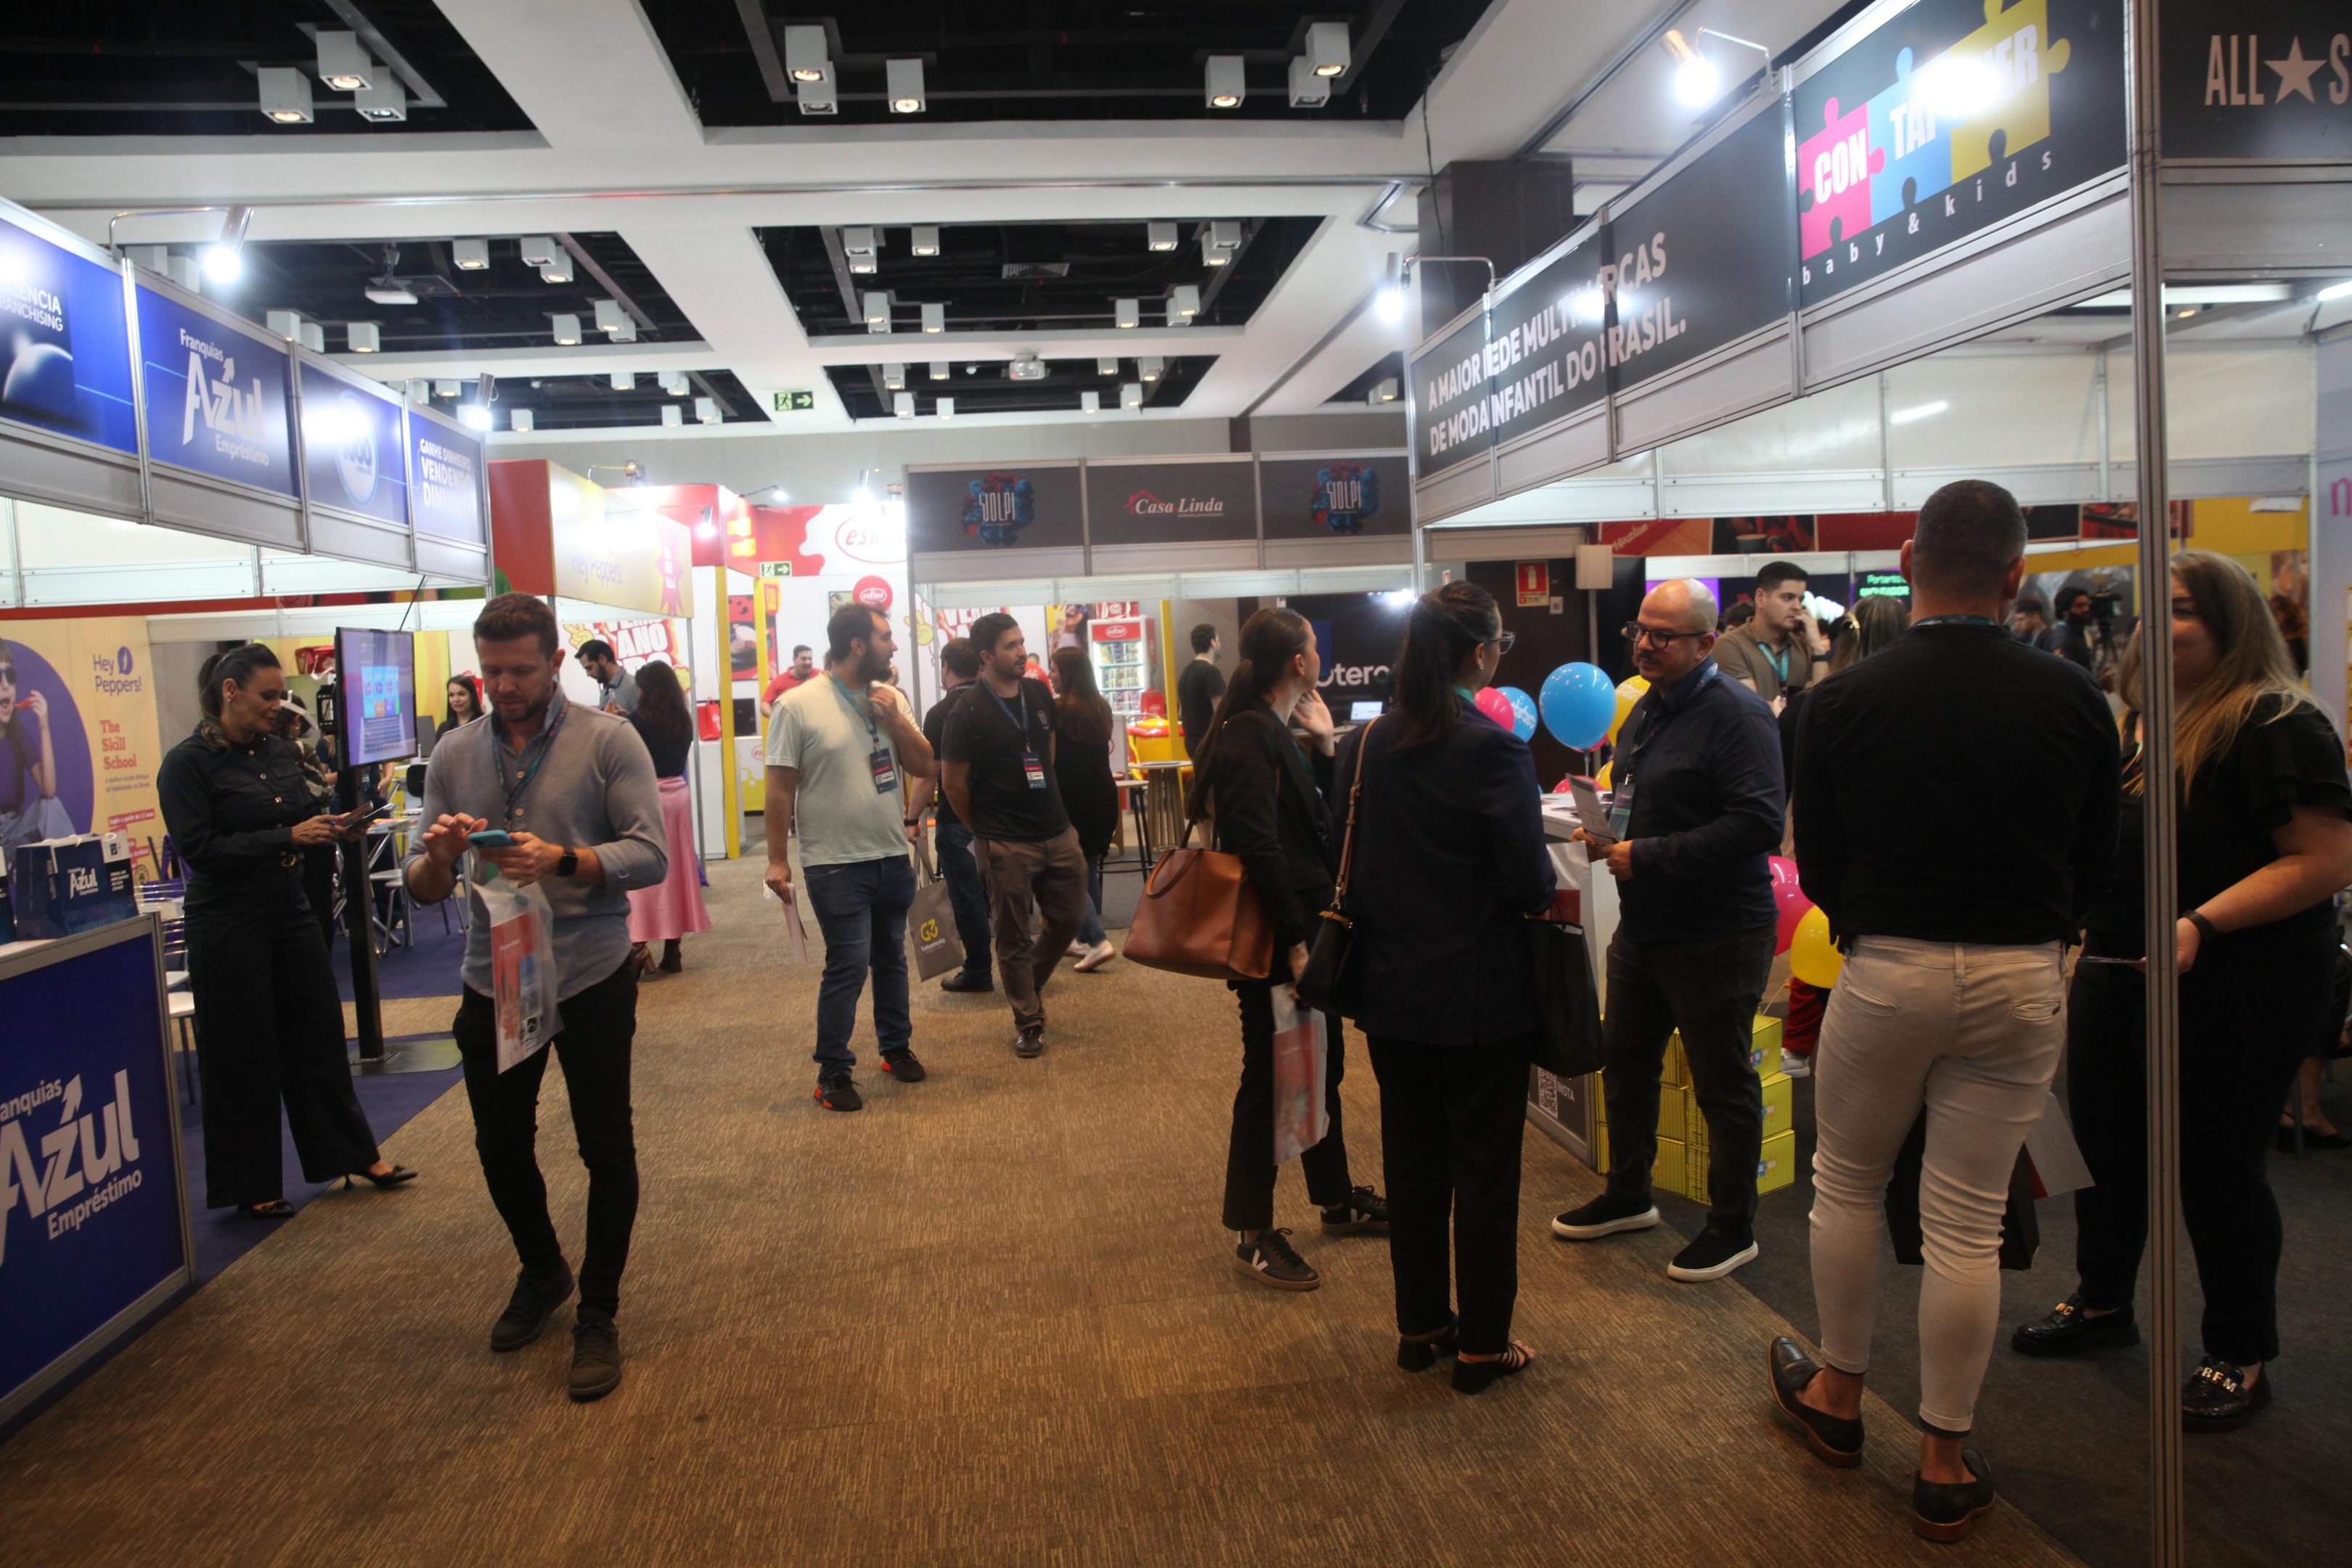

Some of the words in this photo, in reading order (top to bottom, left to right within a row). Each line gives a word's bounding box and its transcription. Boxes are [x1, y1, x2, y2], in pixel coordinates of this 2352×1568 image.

[2205, 35, 2265, 106] ALL
[1815, 128, 1867, 204] CON
[1802, 232, 1885, 285] baby
[1908, 212, 1920, 234] &
[1945, 151, 2051, 217] kids
[180, 328, 224, 362] Franquias
[1429, 381, 1438, 412] A
[1439, 354, 1482, 407] MAIOR
[1430, 420, 1447, 456] DE
[1448, 395, 1490, 448] MODA
[1567, 341, 1596, 391] DO
[216, 433, 269, 466] Empréstimo
[420, 438, 442, 460] GANHE
[421, 457, 472, 489] VENDENDO
[1135, 499, 1174, 514] Casa
[1178, 497, 1224, 513] Linda
[617, 621, 669, 659] ANO
[93, 654, 115, 676] Hey
[94, 675, 142, 697] Peppers!
[100, 719, 121, 733] The
[102, 737, 126, 752] Skill
[104, 754, 137, 770] School
[47, 1169, 142, 1241] Empréstimo
